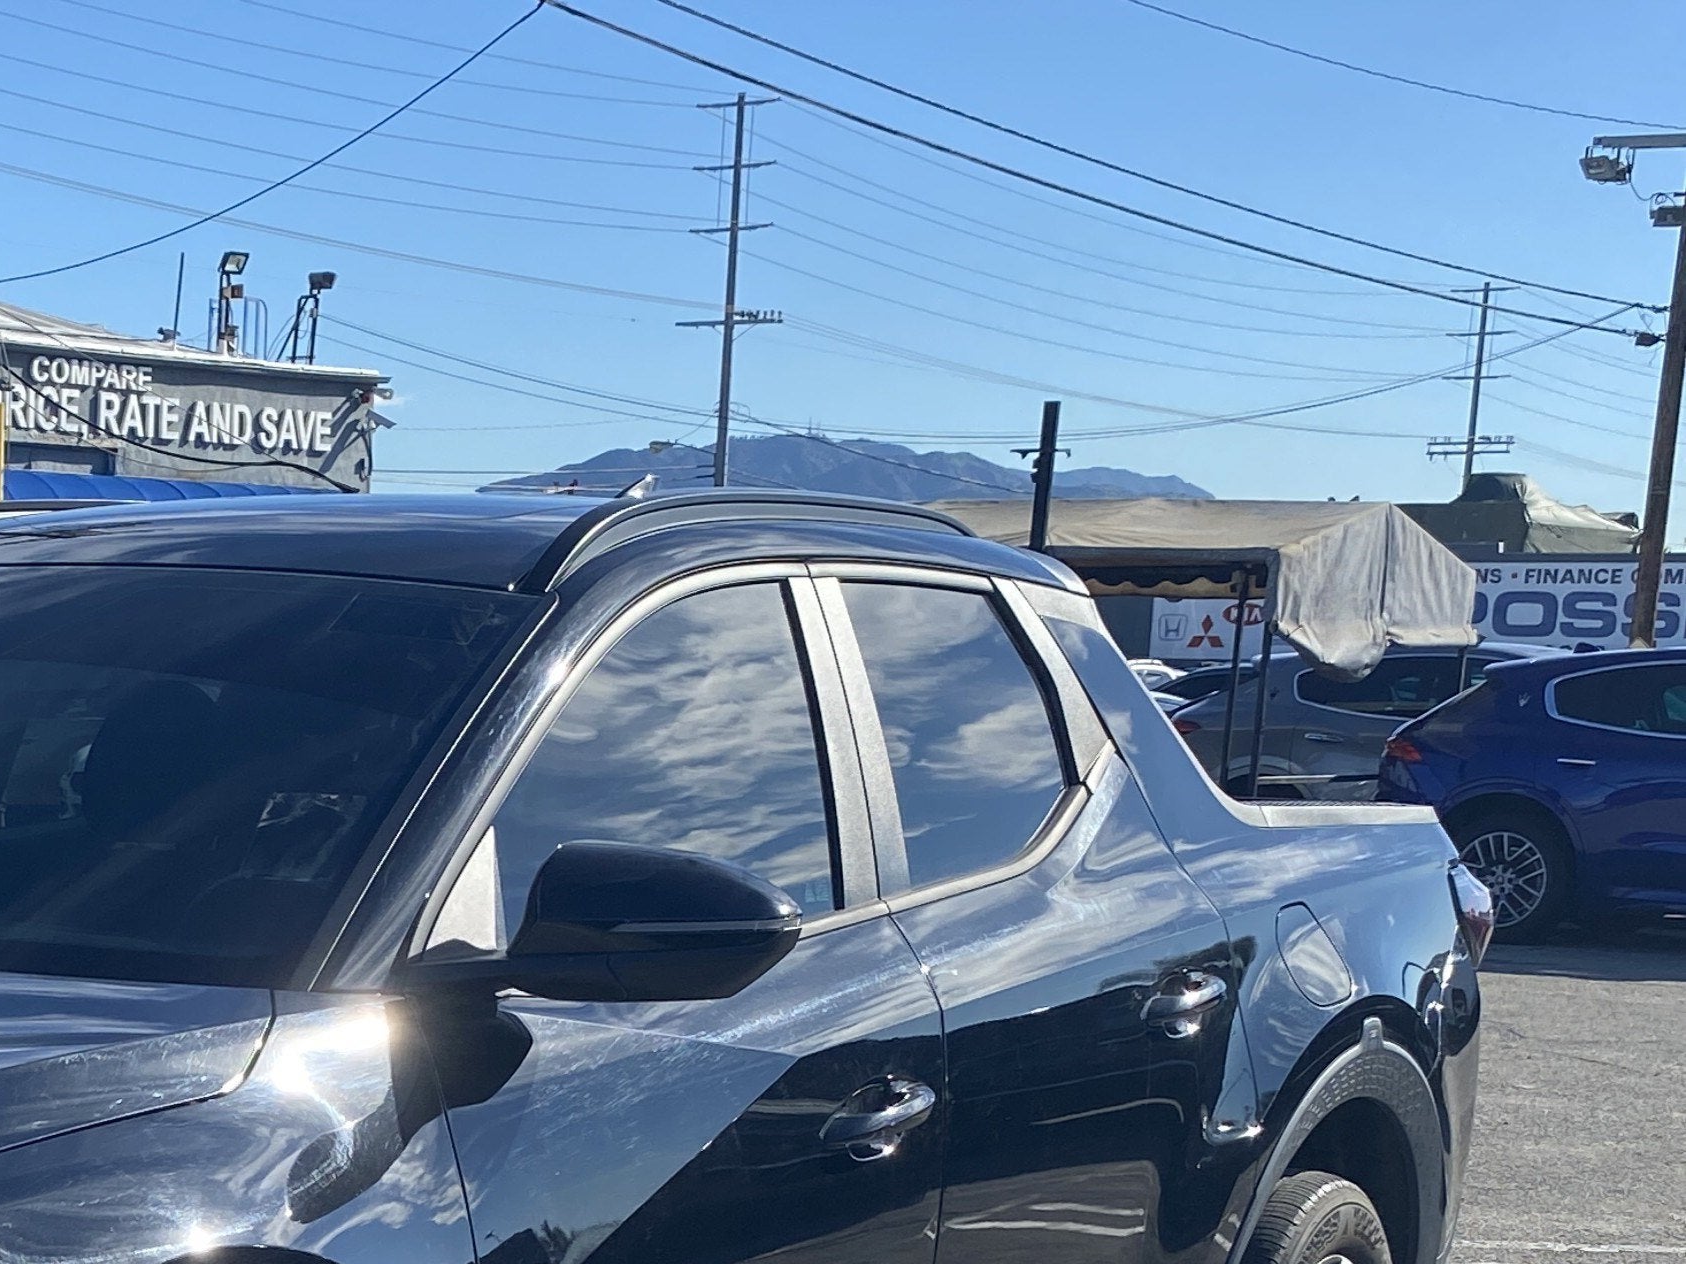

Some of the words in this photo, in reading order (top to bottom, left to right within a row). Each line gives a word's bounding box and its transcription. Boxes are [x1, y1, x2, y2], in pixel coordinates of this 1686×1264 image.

[30, 356, 153, 392] COMPARE
[98, 390, 180, 440] RATE
[189, 400, 252, 445] AND
[258, 406, 332, 451] SAVE
[1524, 568, 1623, 584] FINANCE
